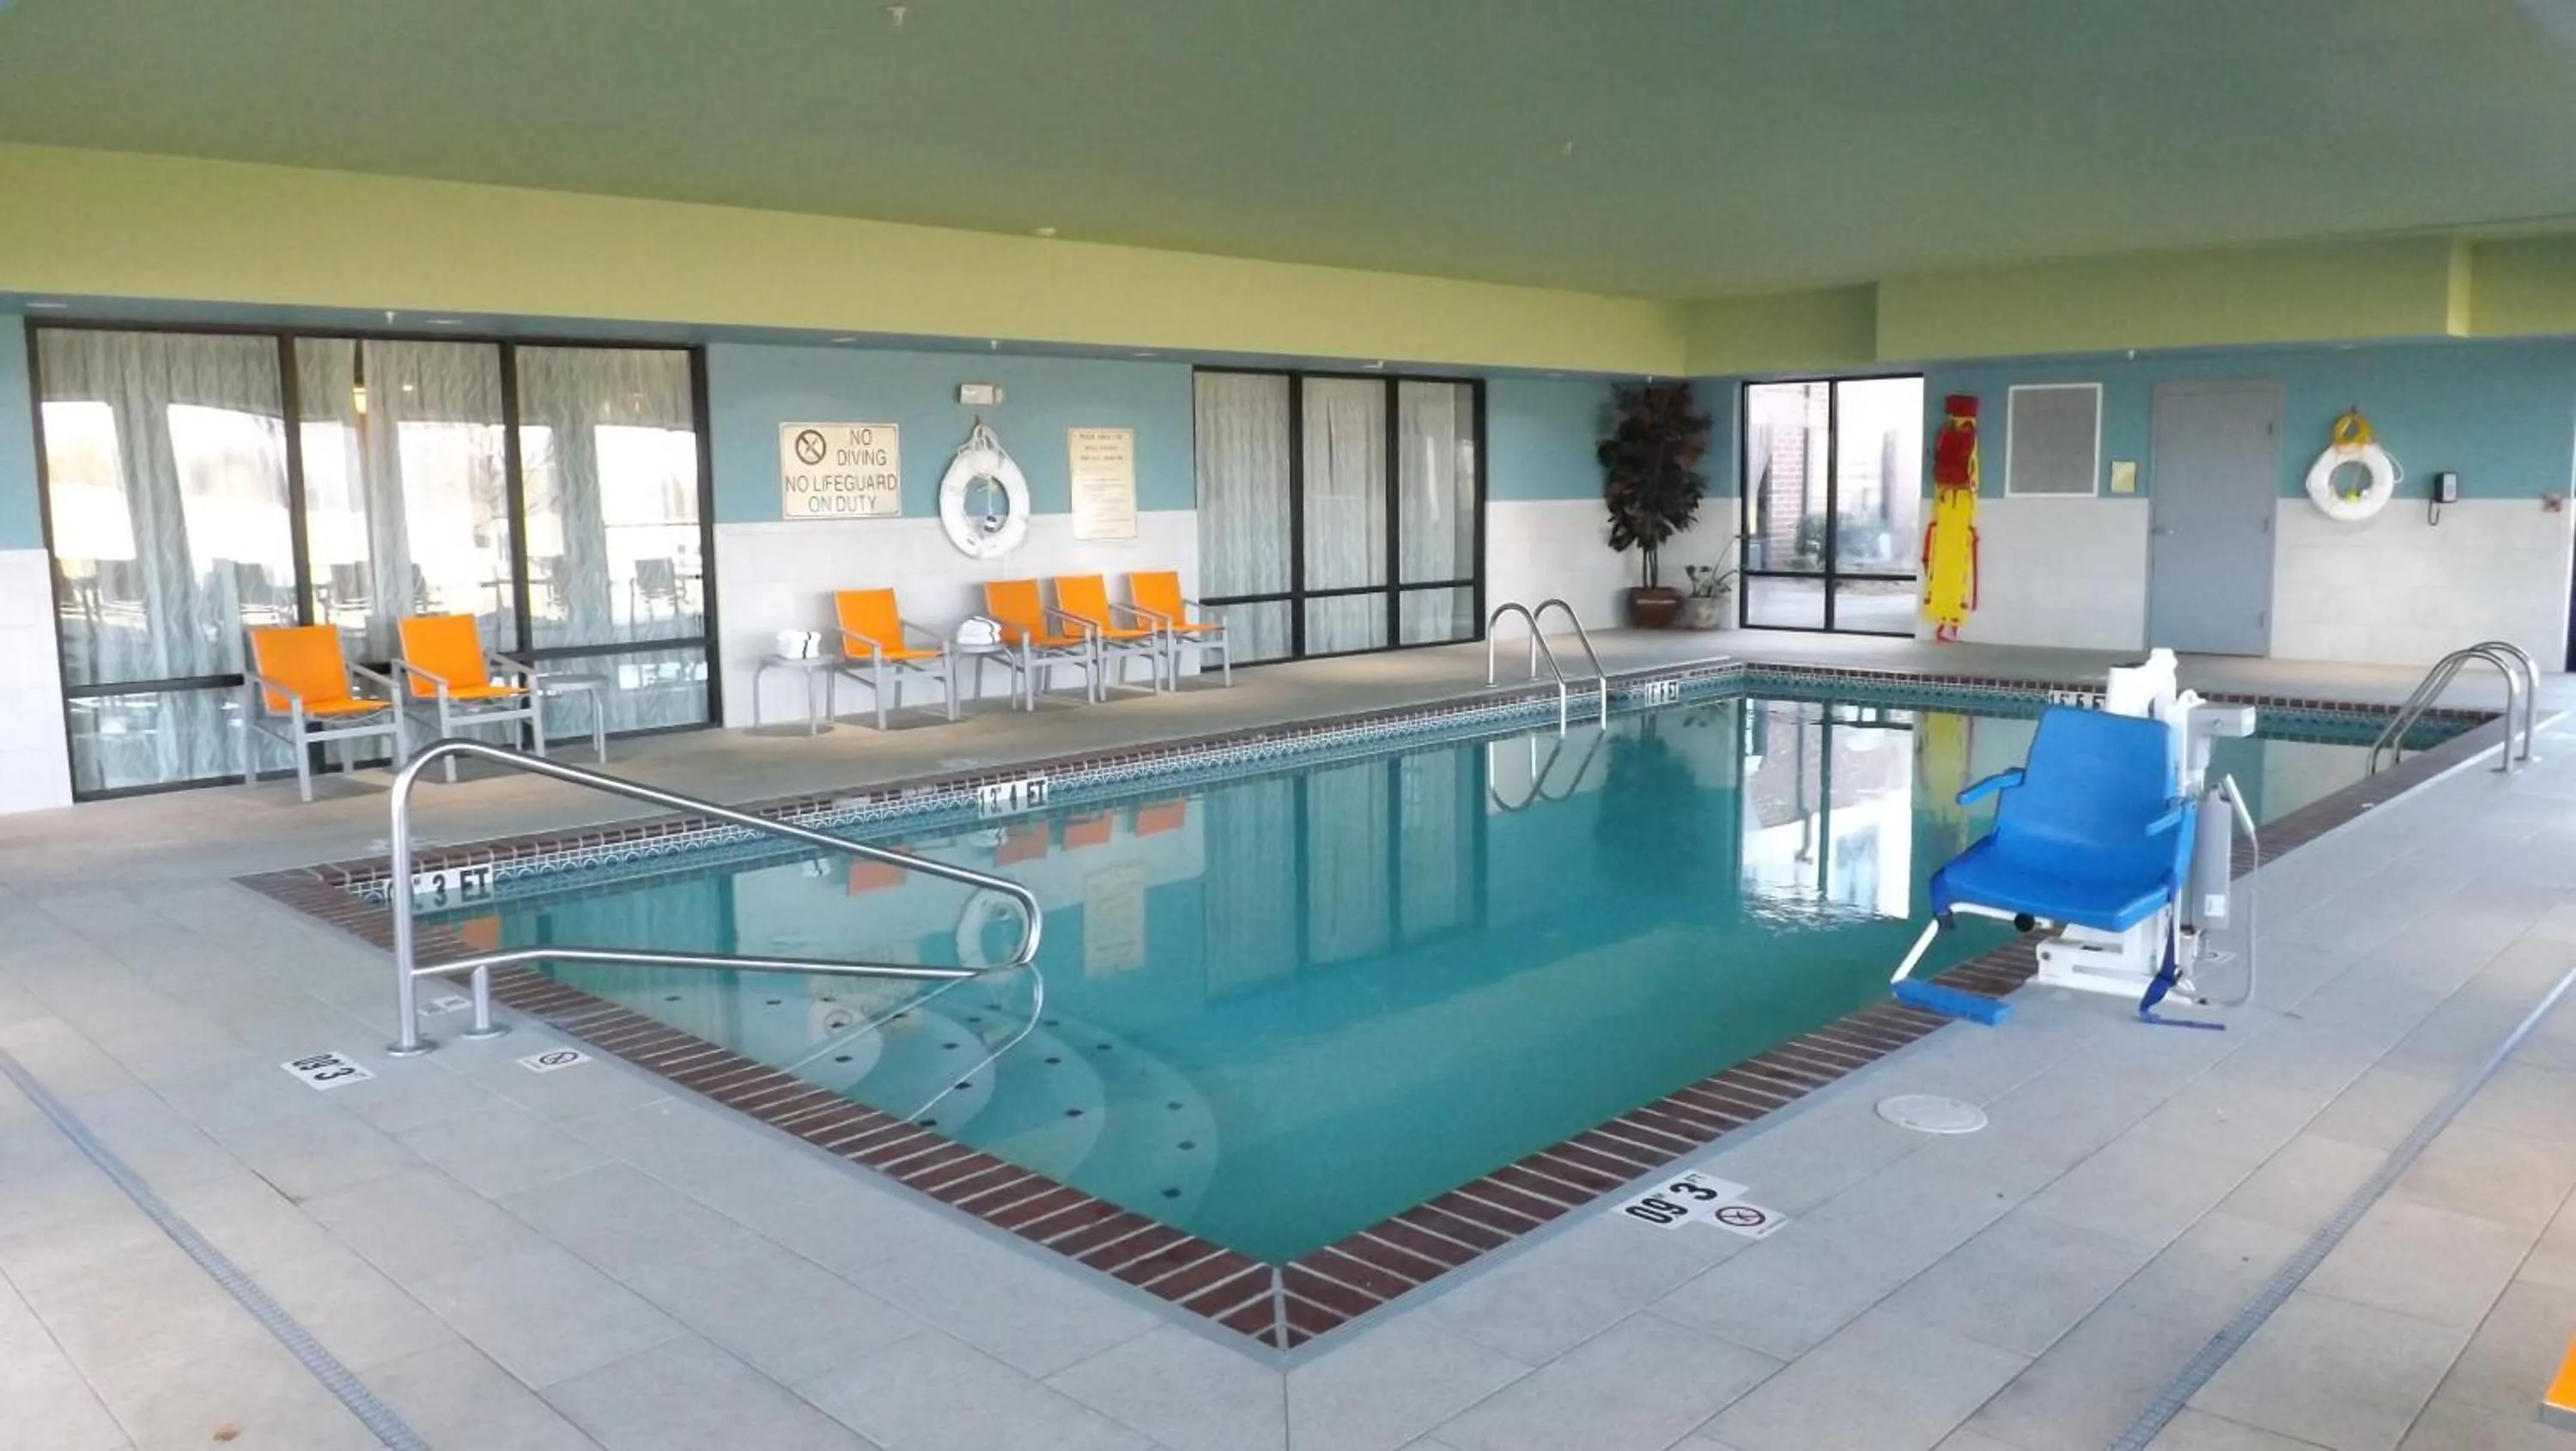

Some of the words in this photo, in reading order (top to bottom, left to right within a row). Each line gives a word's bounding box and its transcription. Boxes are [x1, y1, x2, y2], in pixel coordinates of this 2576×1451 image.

[850, 428, 872, 445] NO
[837, 449, 887, 465] DIVING
[786, 475, 809, 493] NO
[813, 474, 897, 492] LIFEGUARD
[809, 495, 831, 513] ON
[836, 495, 877, 513] DUTY
[1670, 1182, 1717, 1200] 3
